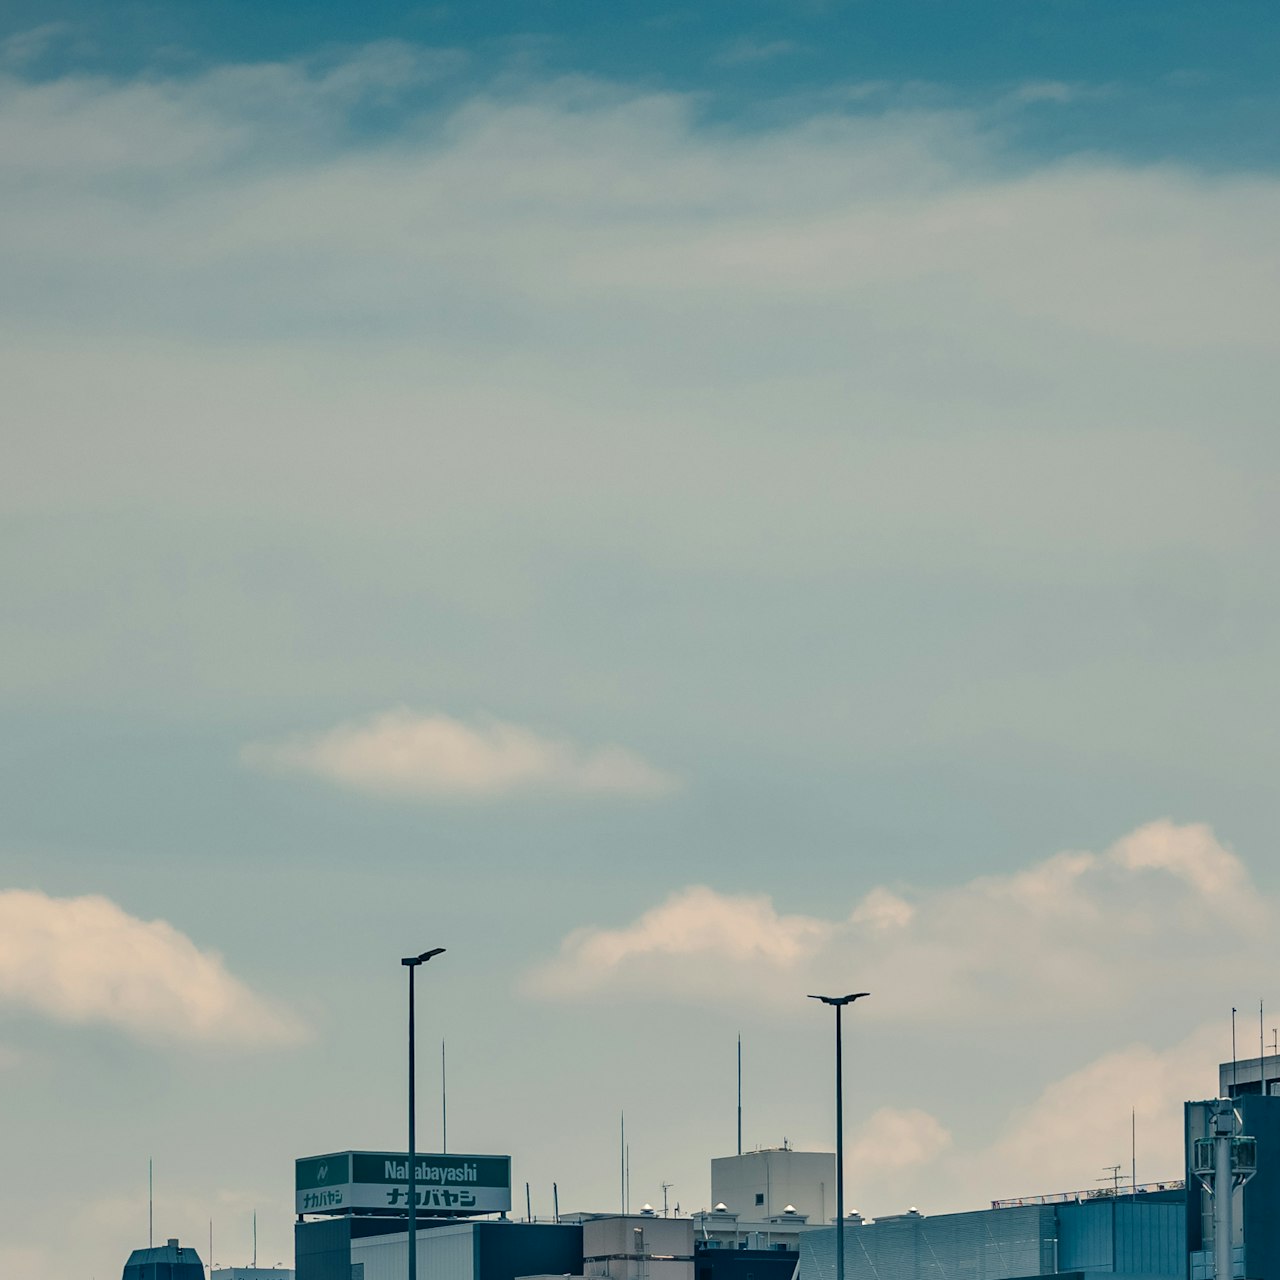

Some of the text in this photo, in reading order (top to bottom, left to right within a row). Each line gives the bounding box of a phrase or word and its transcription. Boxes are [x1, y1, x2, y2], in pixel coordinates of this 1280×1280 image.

[303, 1189, 343, 1209] ナカバヤシ
